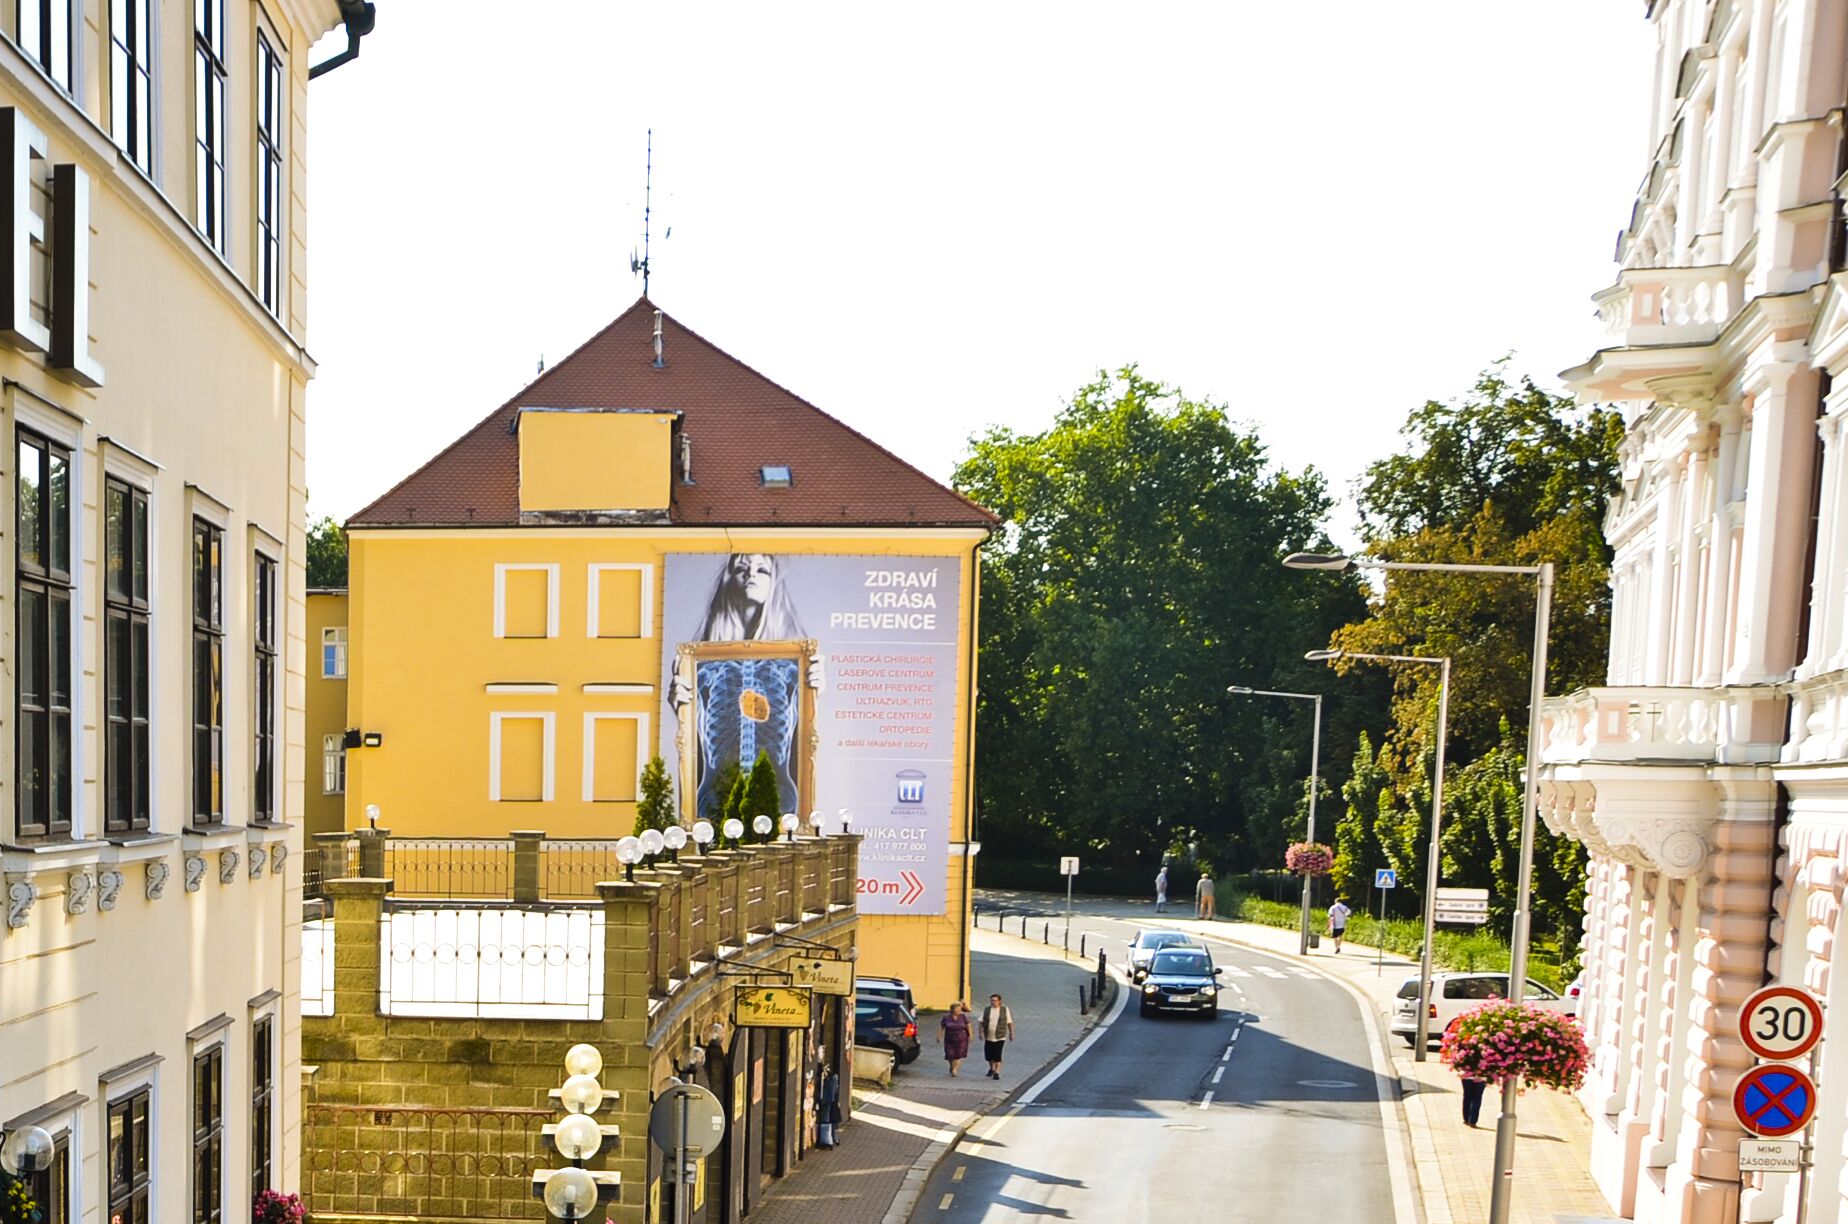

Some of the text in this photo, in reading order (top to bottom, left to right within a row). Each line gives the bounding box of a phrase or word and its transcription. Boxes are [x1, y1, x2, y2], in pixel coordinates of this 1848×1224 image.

[864, 568, 938, 588] ZDRAVÍ
[869, 589, 937, 609] KRÁSA
[830, 612, 936, 630] PREVENCE
[888, 669, 935, 679] CENTRUM
[836, 682, 935, 693] CENTRUM PREVENCE
[886, 711, 933, 721] CENTRUM
[879, 725, 933, 735] ORTOPEDIE
[899, 828, 928, 840] CLT
[882, 882, 900, 894] m
[763, 1002, 797, 1015] Vineta
[1755, 1005, 1806, 1041] 30
[1757, 1146, 1782, 1154] MIMO
